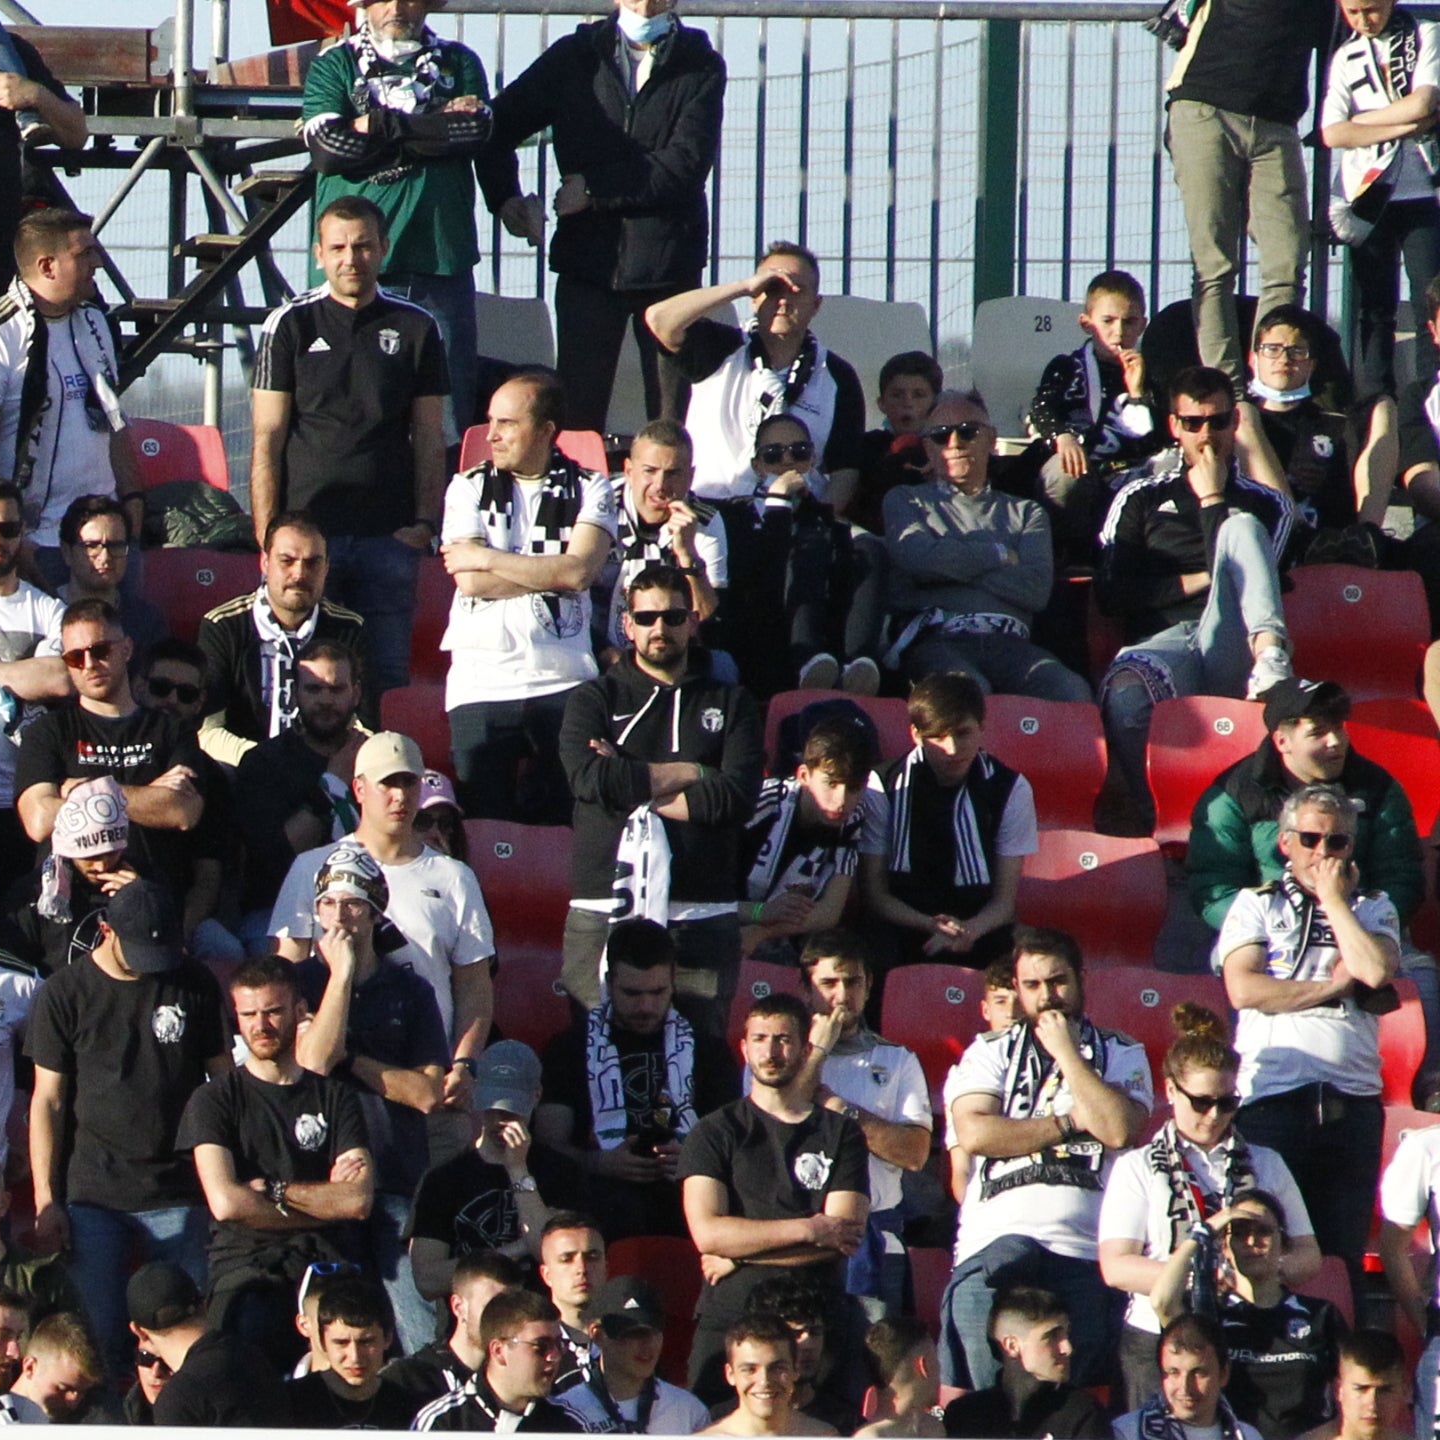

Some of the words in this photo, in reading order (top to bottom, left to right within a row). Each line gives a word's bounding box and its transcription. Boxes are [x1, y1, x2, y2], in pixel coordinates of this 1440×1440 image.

[1034, 315, 1052, 332] 28
[144, 442, 158, 453] 63
[198, 572, 212, 584] 63
[1022, 720, 1036, 731] 67
[1216, 721, 1231, 731] 68
[496, 845, 510, 855] 64
[1082, 856, 1095, 866] 67
[754, 985, 768, 996] 65
[948, 989, 962, 1001] 66
[1143, 993, 1156, 1004] 67
